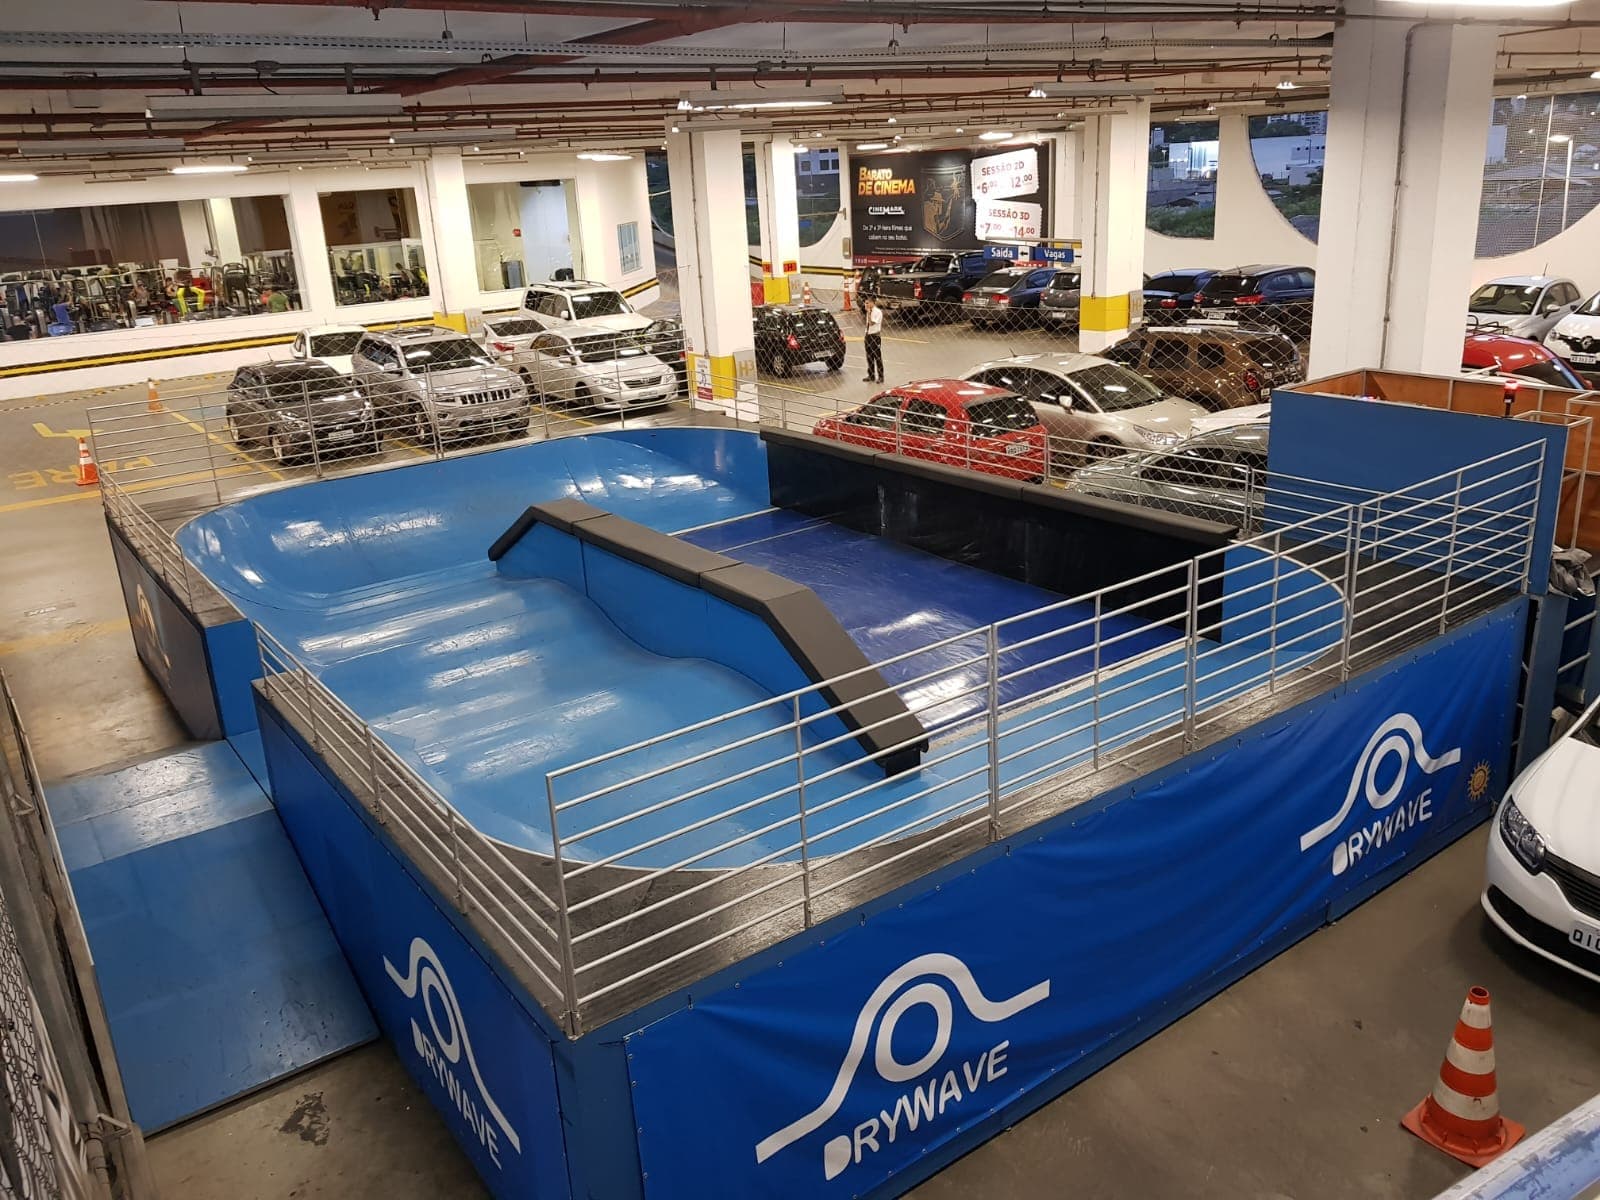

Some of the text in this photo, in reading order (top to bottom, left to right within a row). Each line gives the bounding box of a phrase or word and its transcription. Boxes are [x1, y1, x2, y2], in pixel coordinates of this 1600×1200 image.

[860, 167, 893, 181] BARATO
[981, 161, 1025, 176] SESSÃO 2D
[858, 179, 916, 196] DE CINEMA
[868, 206, 905, 215] CINEMARK
[988, 208, 1031, 220] SESSÃO 3D
[991, 247, 1014, 258] Saída
[1044, 249, 1066, 260] Vagas
[1332, 788, 1432, 876] DRYWAVE
[410, 1016, 502, 1170] DRYWAVE
[824, 1040, 1009, 1181] DRYWAVE
